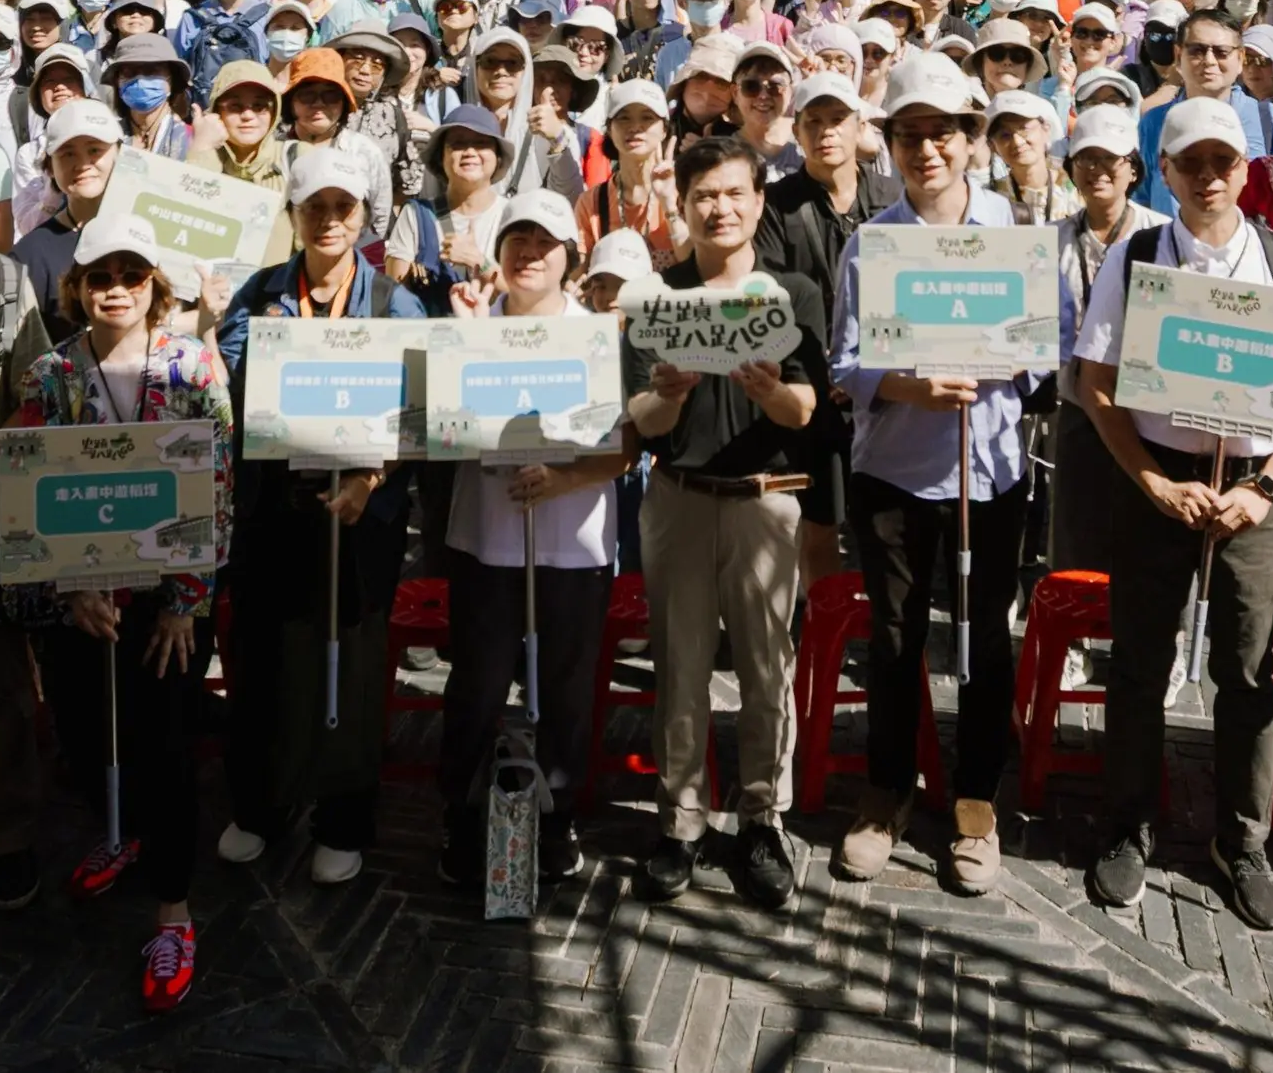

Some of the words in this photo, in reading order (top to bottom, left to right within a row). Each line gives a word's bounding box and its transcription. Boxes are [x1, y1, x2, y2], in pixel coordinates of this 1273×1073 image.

[173, 230, 189, 246] A
[643, 295, 712, 326] 史蹟
[951, 299, 968, 318] A
[638, 328, 665, 339] 2025
[1216, 353, 1233, 373] B
[335, 390, 350, 409] B
[516, 389, 532, 408] A
[55, 483, 159, 501] 走入畫中遊稻埕
[98, 504, 115, 524] C
